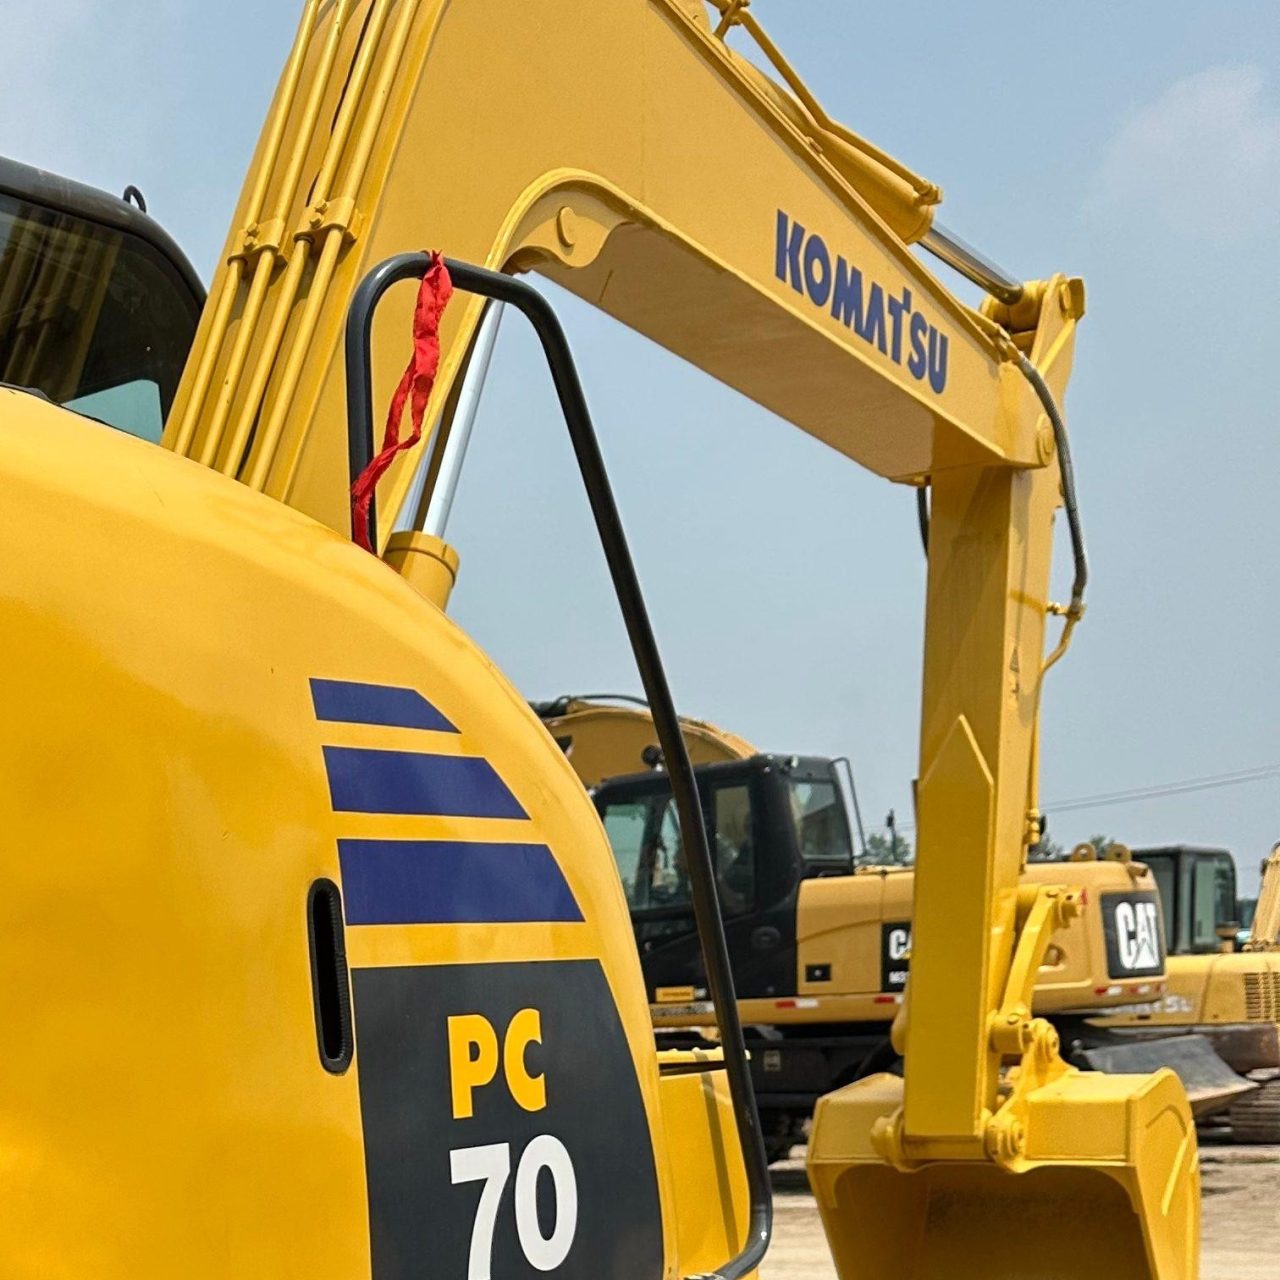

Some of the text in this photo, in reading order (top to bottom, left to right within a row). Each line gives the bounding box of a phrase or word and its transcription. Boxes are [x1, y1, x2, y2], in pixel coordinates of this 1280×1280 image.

[775, 208, 948, 394] KOMATSU
[1115, 901, 1160, 969] CAT
[447, 1008, 546, 1119] PC
